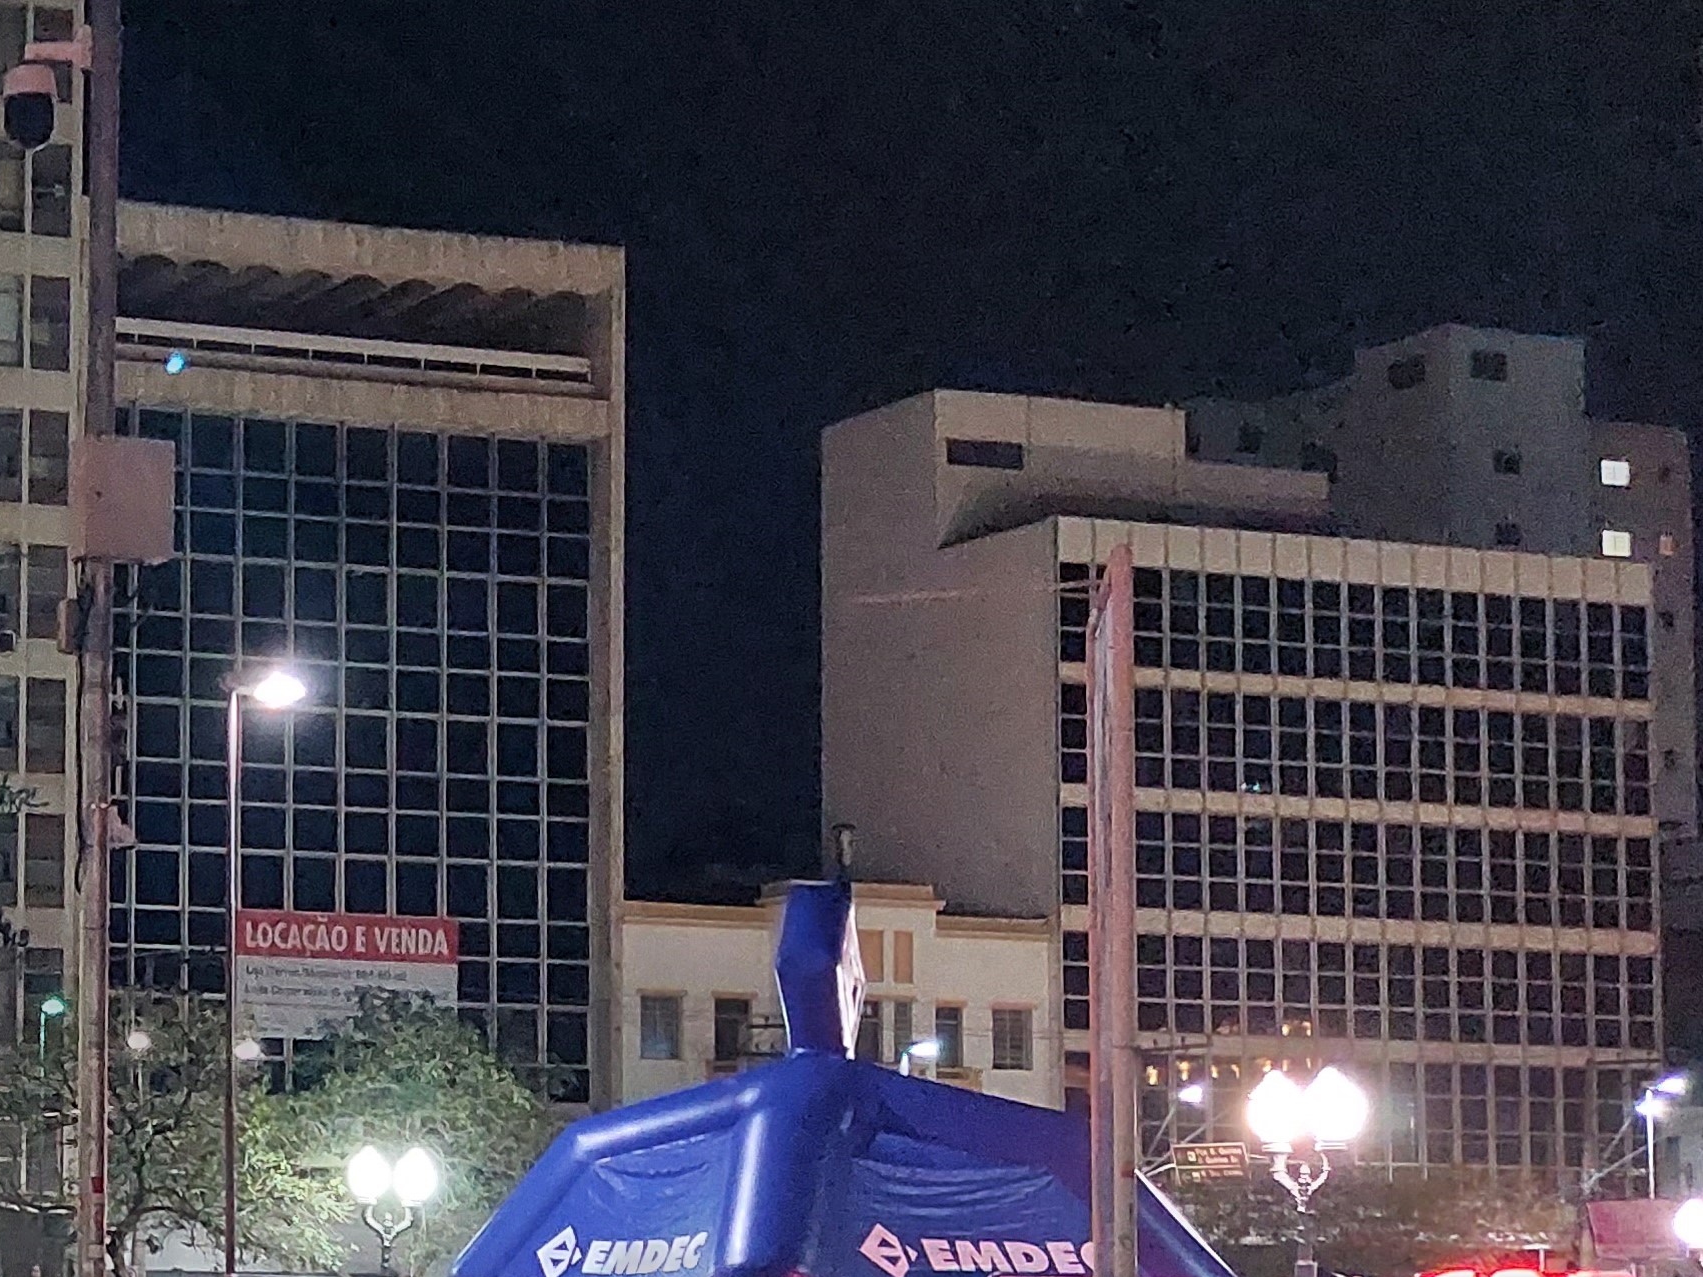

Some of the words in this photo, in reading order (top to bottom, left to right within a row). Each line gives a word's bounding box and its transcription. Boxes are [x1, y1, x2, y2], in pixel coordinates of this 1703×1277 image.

[245, 915, 348, 957] LOCAÇÃO
[355, 925, 366, 953] E
[374, 926, 449, 956] VENDA
[581, 1231, 709, 1276] EMDEC
